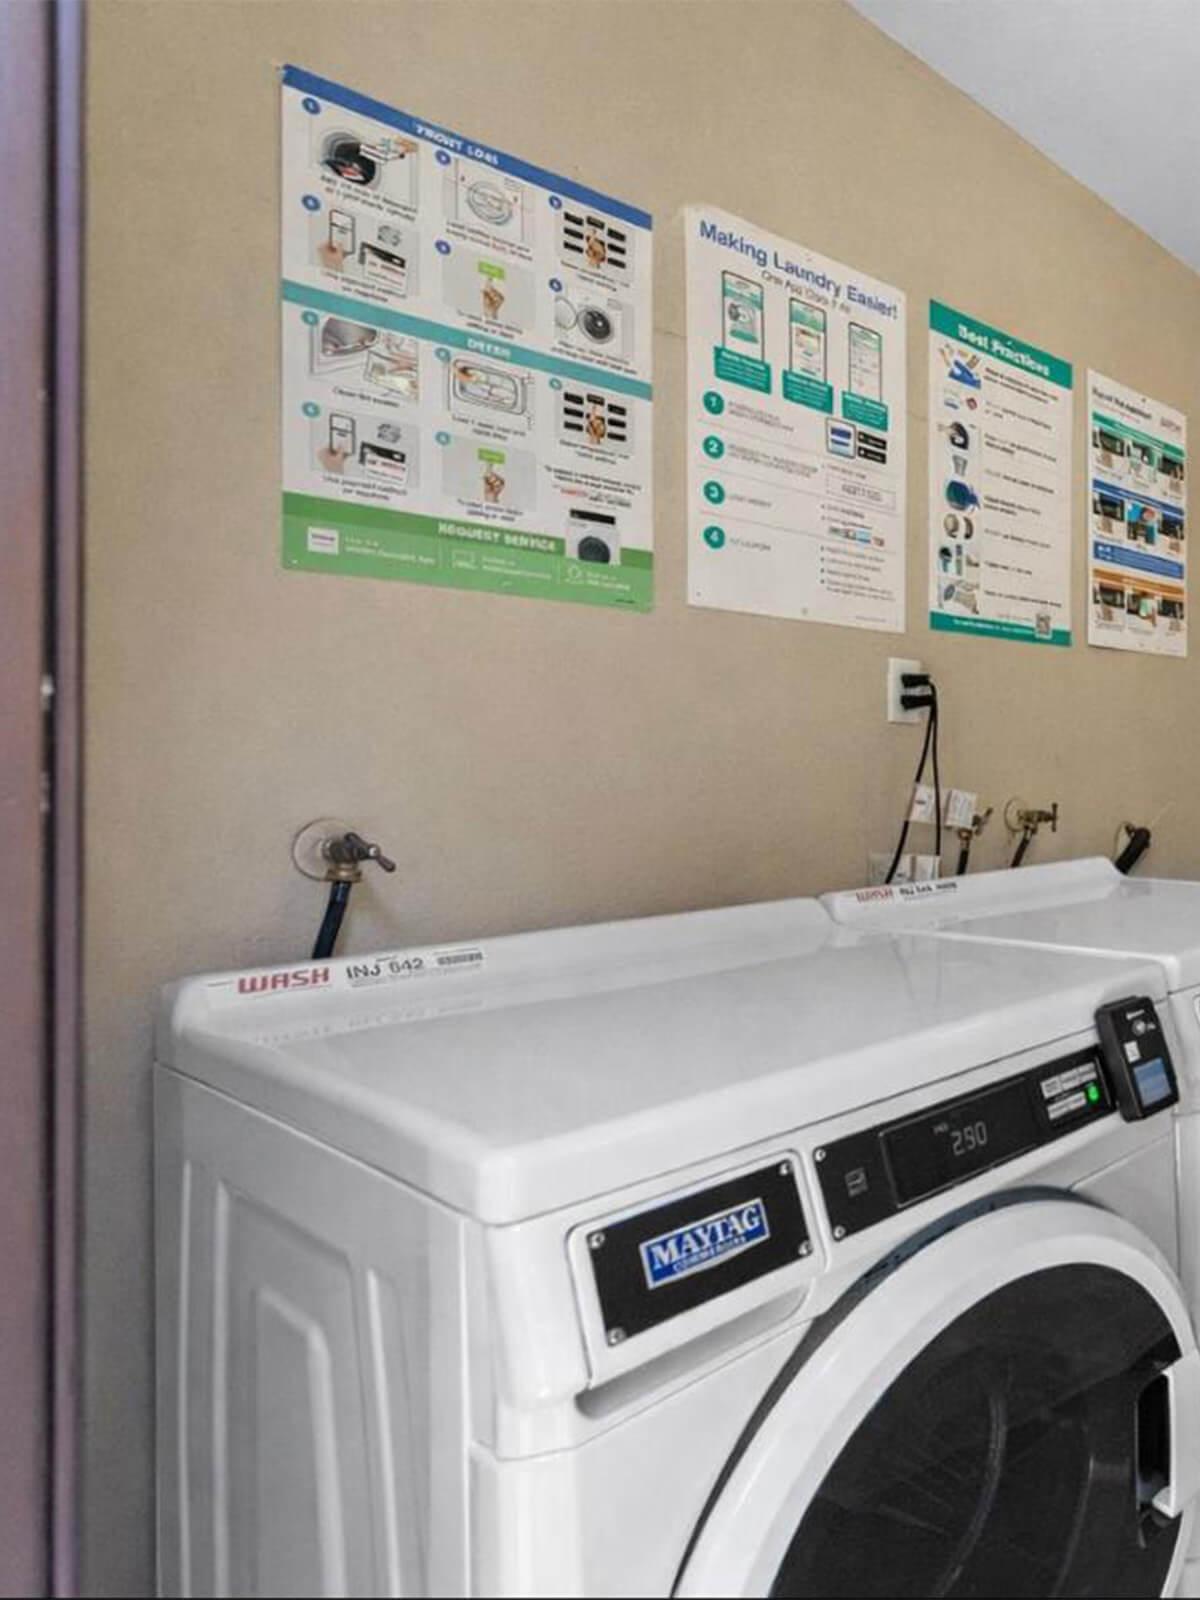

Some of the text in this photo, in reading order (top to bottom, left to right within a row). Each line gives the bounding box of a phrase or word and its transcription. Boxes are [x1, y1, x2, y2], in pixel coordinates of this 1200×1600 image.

[700, 220, 899, 320] Making Laundry Easier!
[958, 323, 989, 350] Best
[709, 440, 718, 453] 2
[709, 485, 719, 498] 3
[237, 966, 330, 995] WASH
[346, 963, 381, 980] INJ
[650, 1206, 761, 1271] MAYTAG
